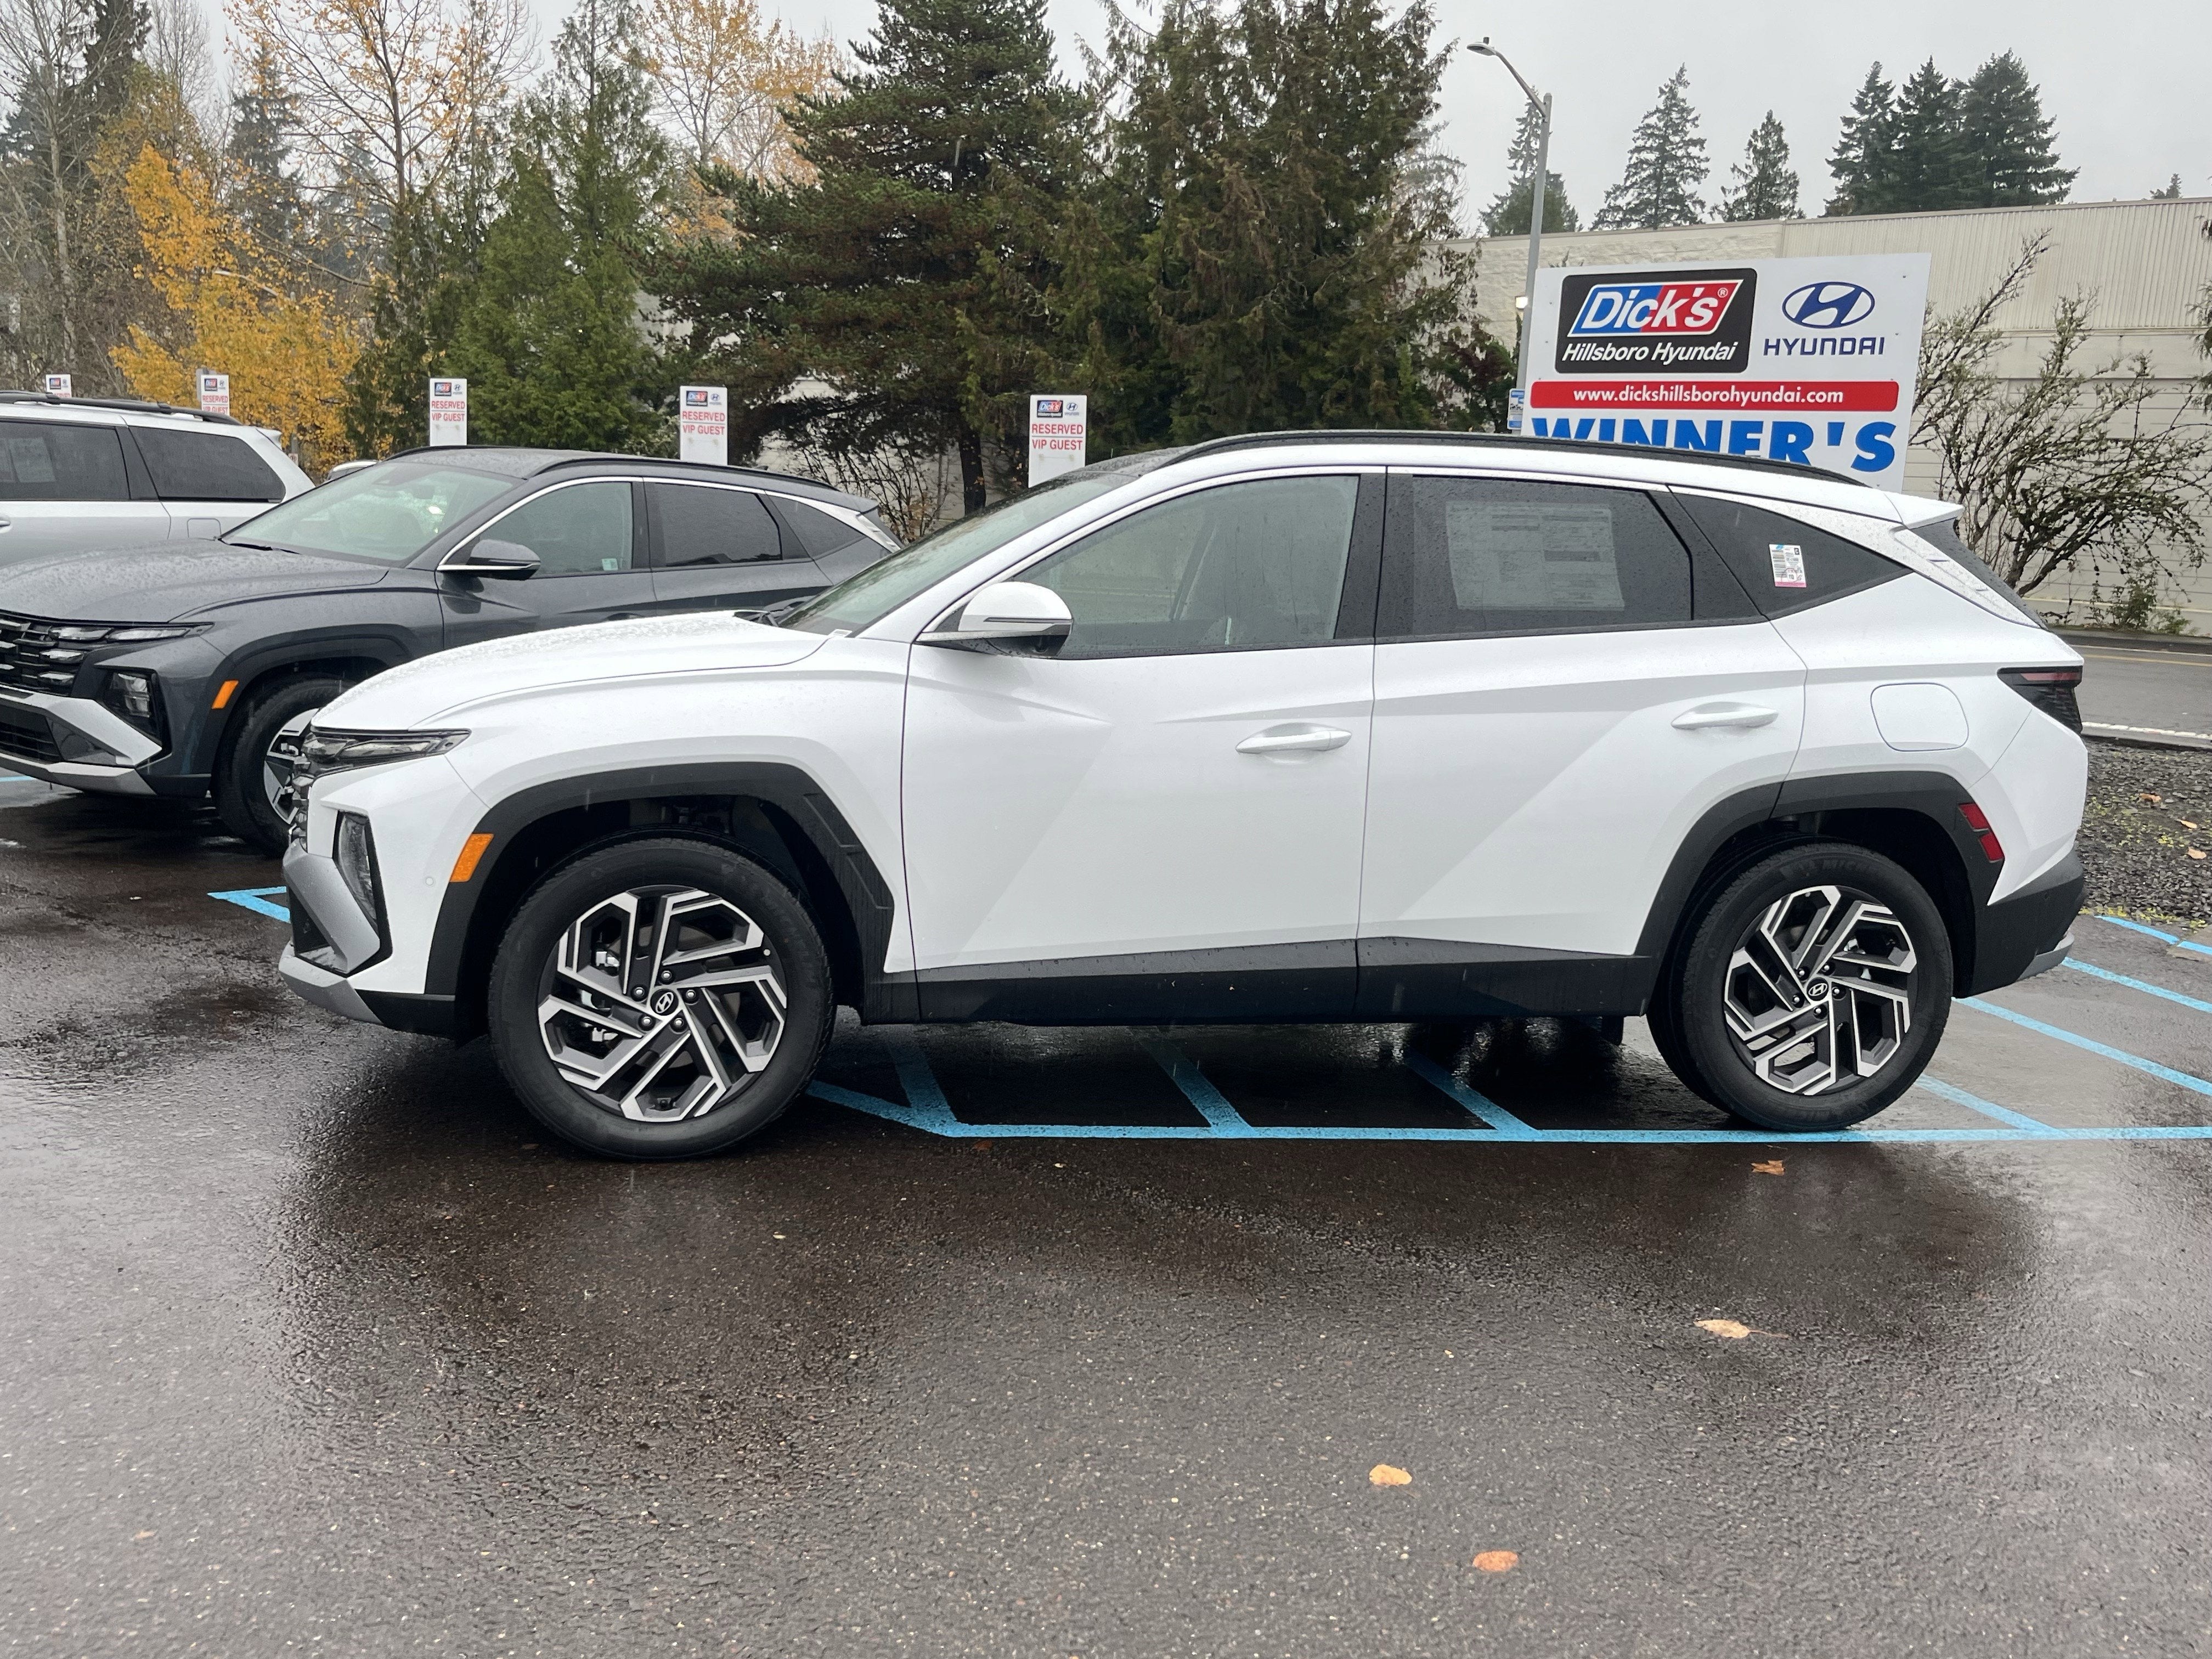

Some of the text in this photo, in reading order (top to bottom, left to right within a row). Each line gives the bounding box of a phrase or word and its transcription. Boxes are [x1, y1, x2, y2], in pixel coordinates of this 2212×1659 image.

[1581, 287, 1718, 329] Dick's
[1763, 337, 1885, 356] HYUNDAI
[1561, 341, 1739, 365] Hillsboro Hyundai
[1573, 385, 1843, 407] www.dickshillsborohyundai.com
[431, 401, 465, 409] RESERVED
[443, 413, 465, 421] GUEST
[682, 411, 725, 421] RESERVED
[682, 425, 725, 435] VIP GUEST
[1032, 424, 1084, 435] RESERVED
[1032, 439, 1082, 450] VIP GUEST
